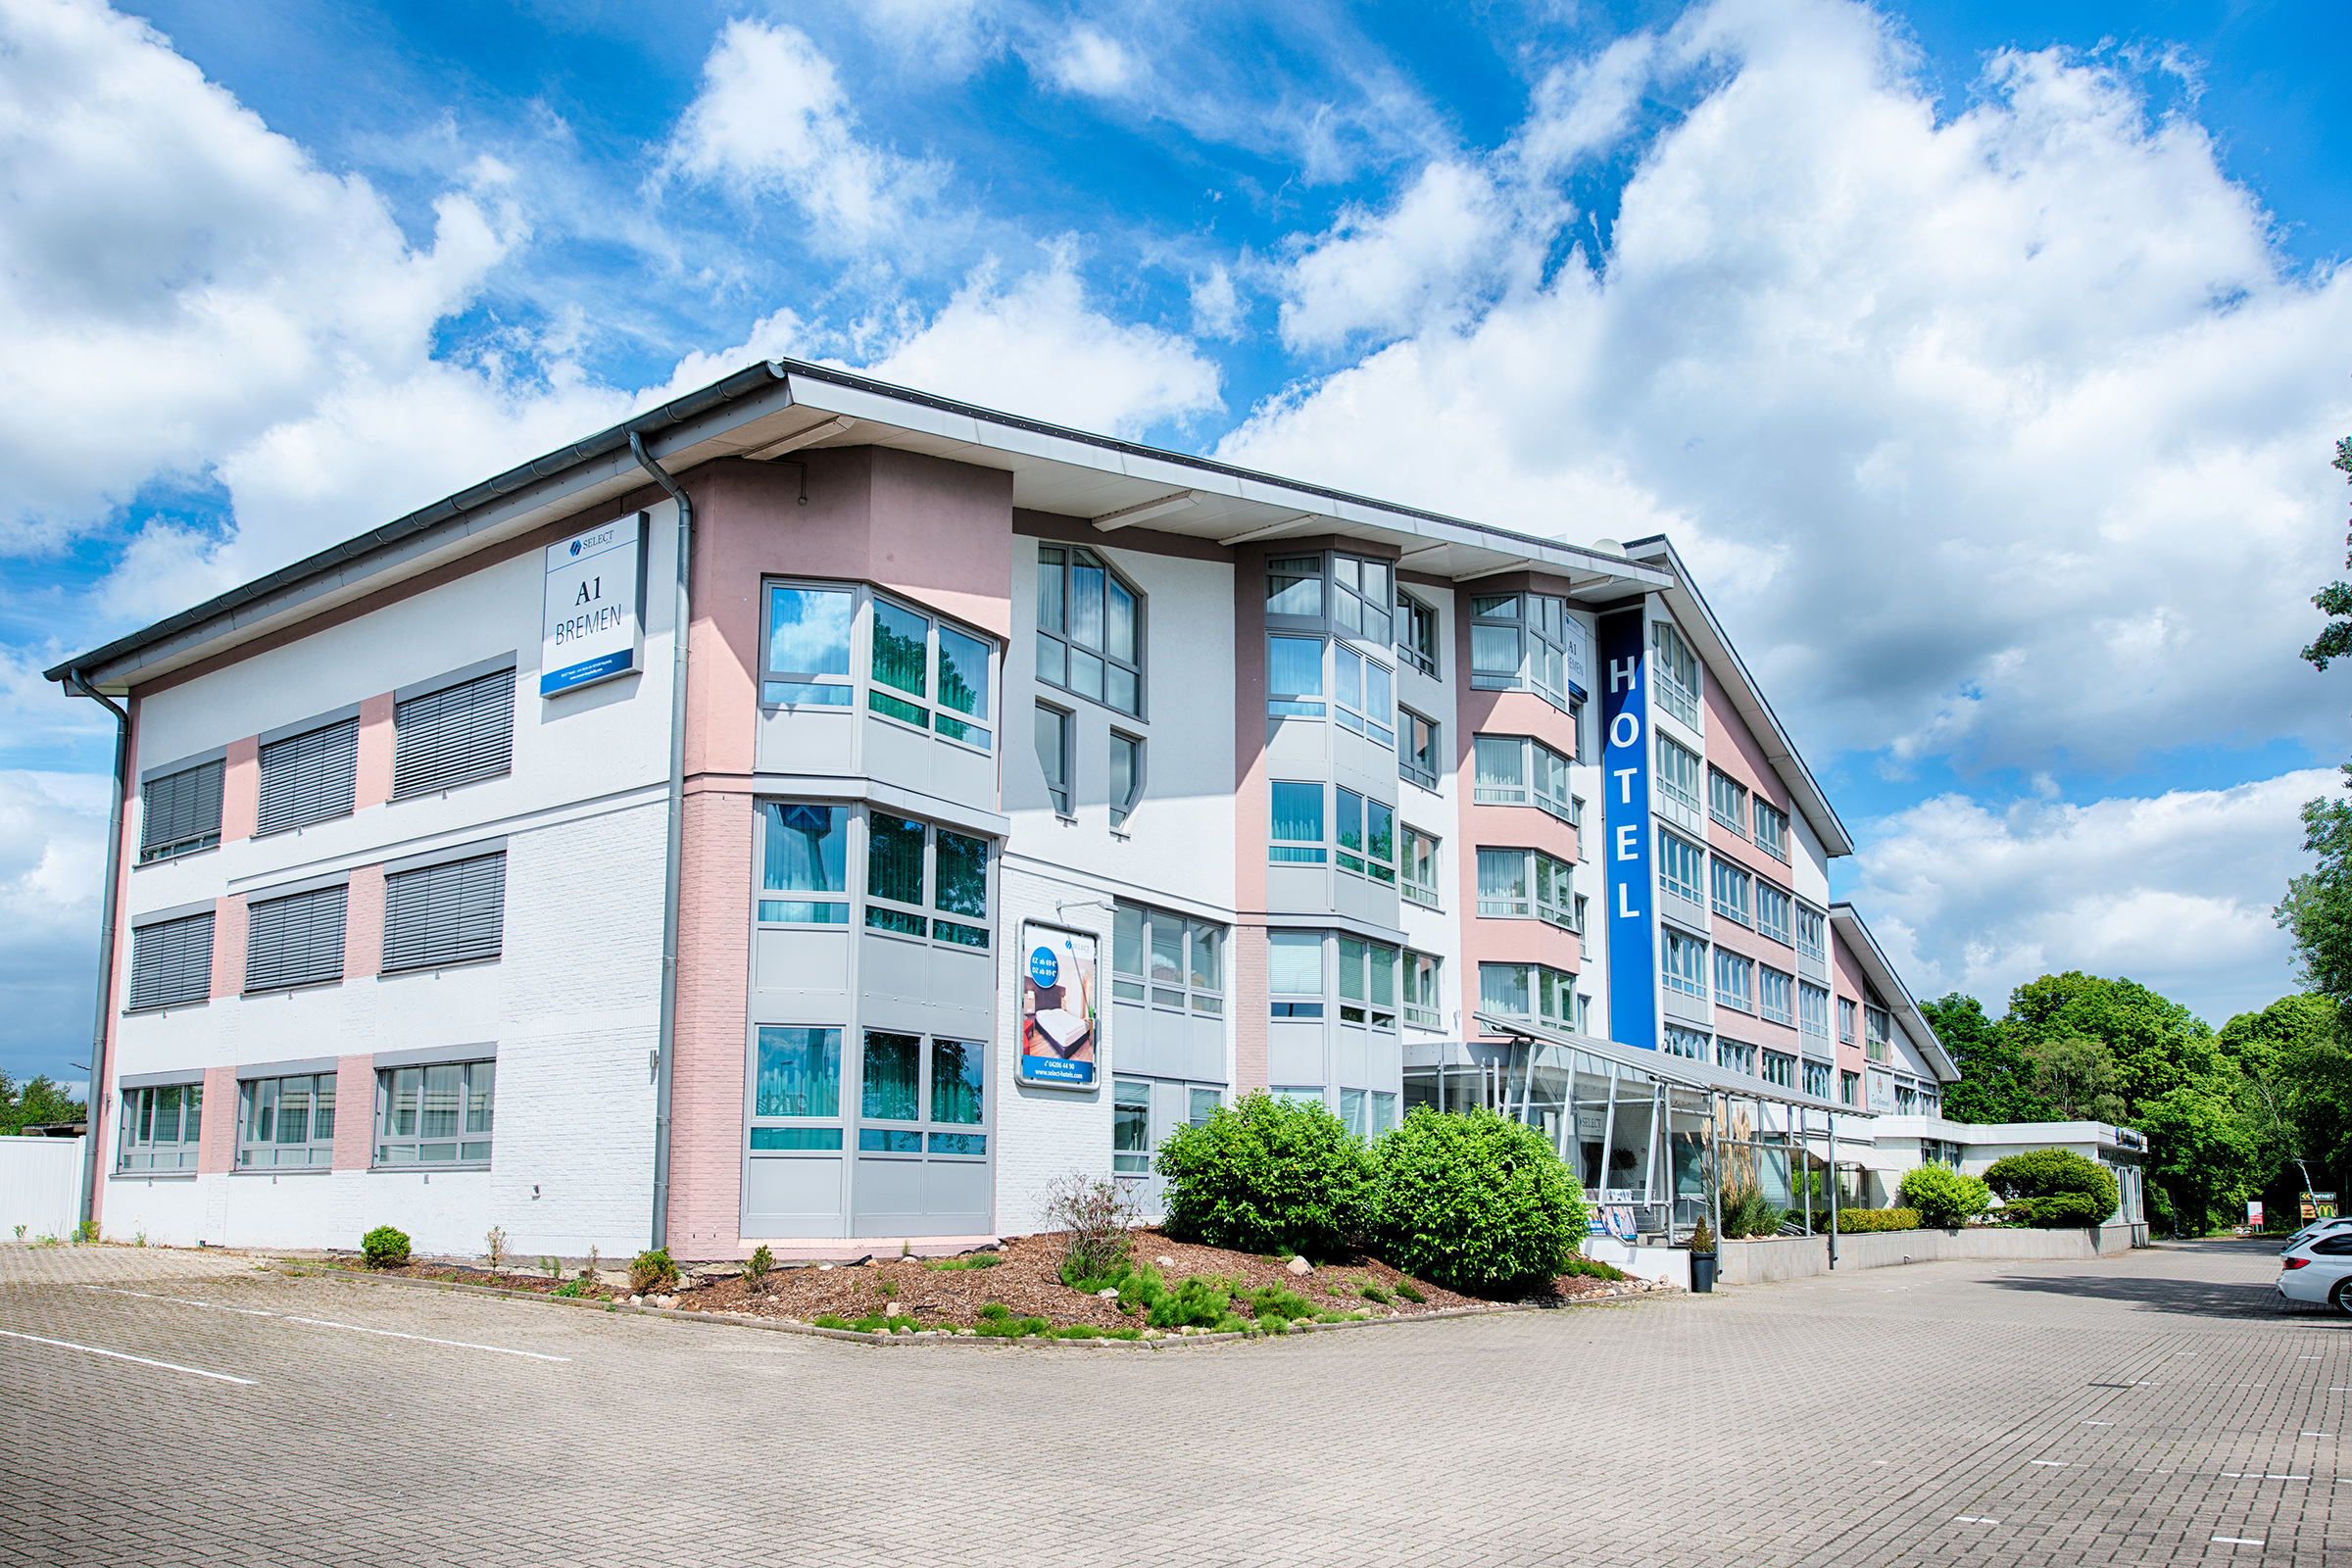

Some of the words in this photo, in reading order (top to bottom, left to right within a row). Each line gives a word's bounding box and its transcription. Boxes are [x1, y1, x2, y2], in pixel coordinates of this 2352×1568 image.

[583, 529, 614, 550] SELECT
[575, 576, 601, 607] A1
[556, 604, 621, 646] BREMEN
[1568, 640, 1577, 656] A1
[1609, 656, 1640, 918] HOTEL
[1582, 1117, 1601, 1128] SELECT
